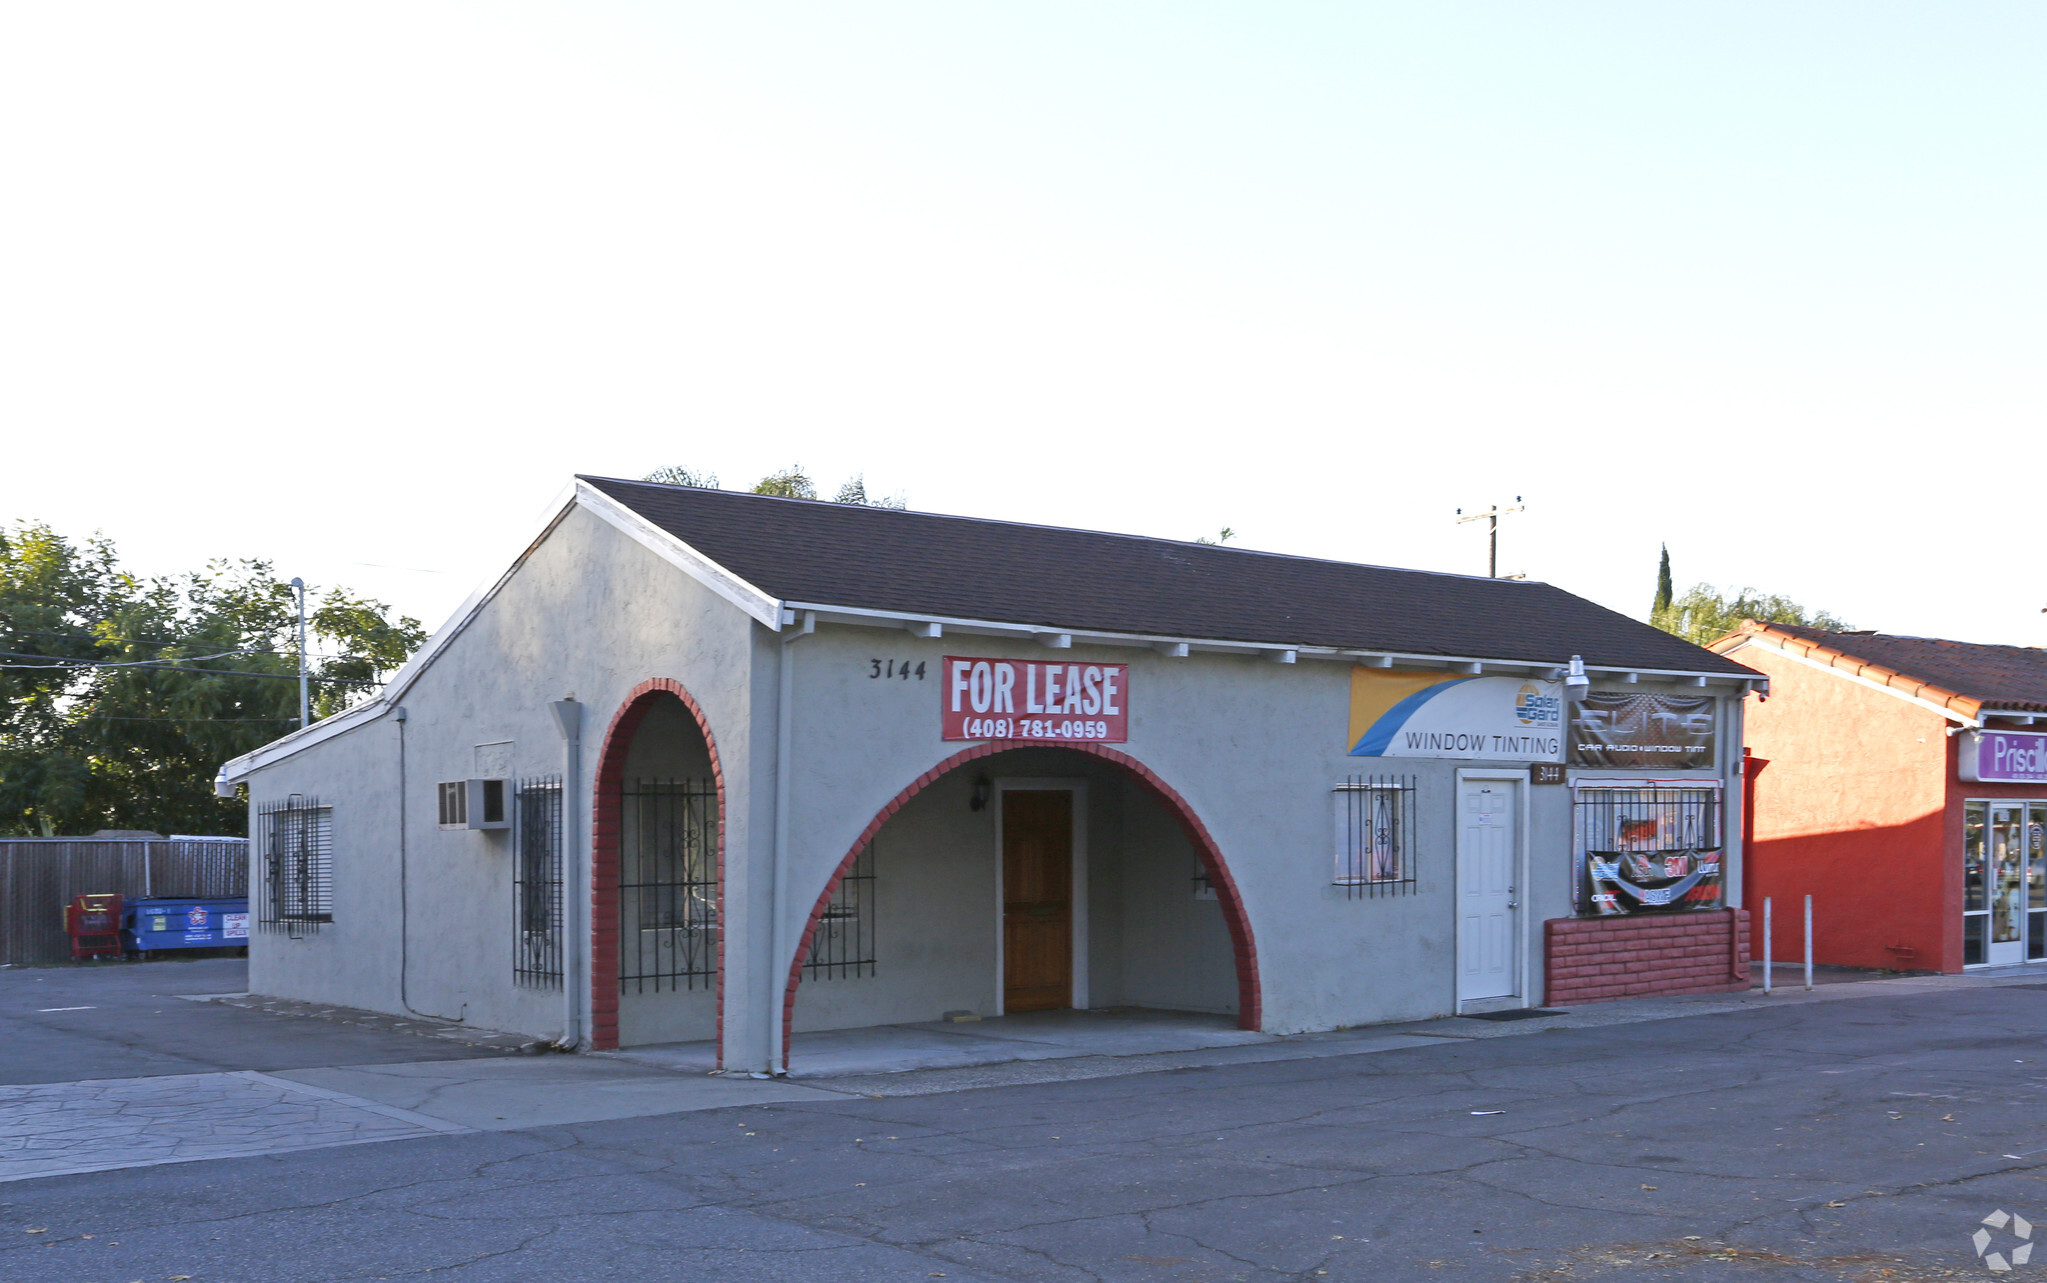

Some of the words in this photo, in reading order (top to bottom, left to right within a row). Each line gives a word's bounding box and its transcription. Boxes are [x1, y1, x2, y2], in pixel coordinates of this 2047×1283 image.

[869, 658, 927, 680] 3144
[951, 660, 1015, 713] FOR
[1026, 664, 1120, 716] LEASE
[1525, 694, 1559, 708] Solar
[1527, 707, 1559, 721] Gard
[1571, 709, 1714, 735] ELITE
[962, 717, 1014, 739] (408)
[1020, 720, 1108, 739] 781-0959
[1406, 732, 1486, 751] WINDOW
[1493, 735, 1559, 755] TINTING
[1577, 743, 1603, 751] CAR
[1605, 744, 1638, 752] AUDIO
[1539, 766, 1560, 781] 3144
[1664, 856, 1688, 877] 3M
